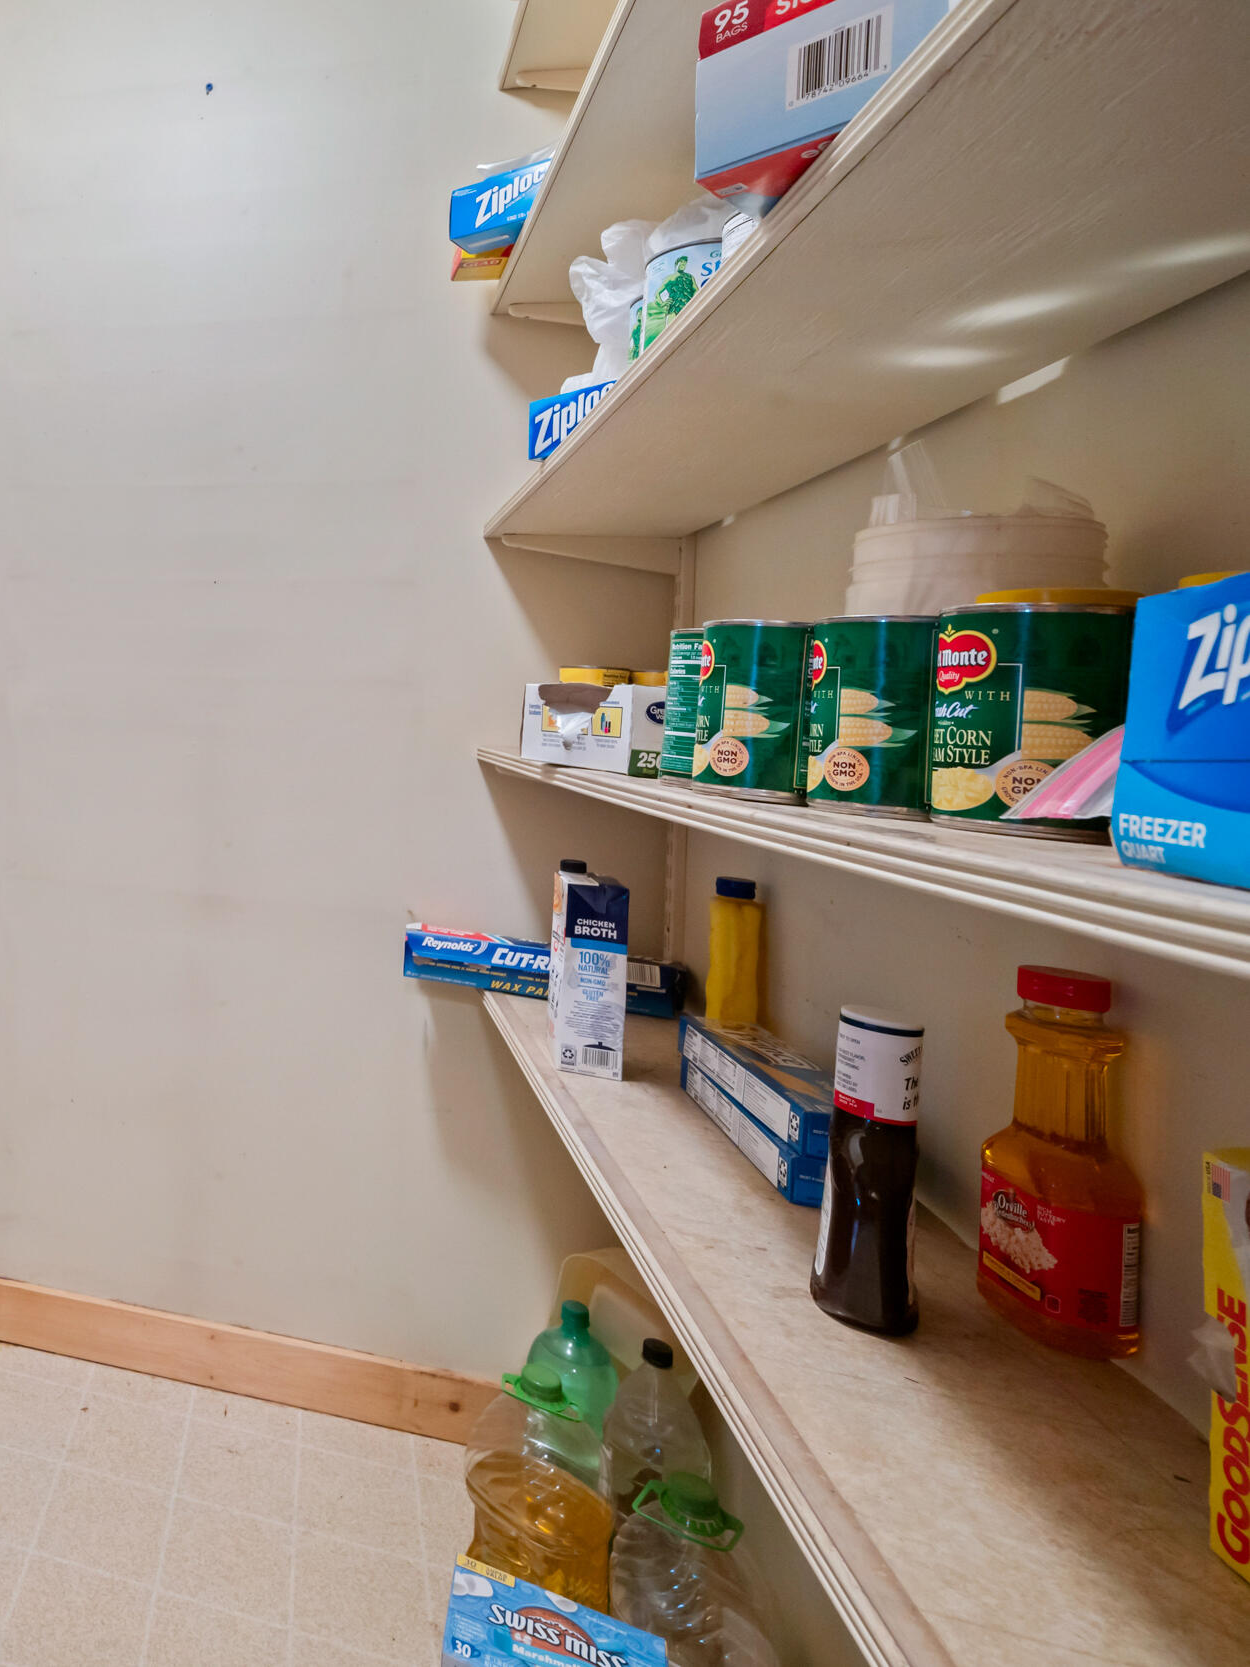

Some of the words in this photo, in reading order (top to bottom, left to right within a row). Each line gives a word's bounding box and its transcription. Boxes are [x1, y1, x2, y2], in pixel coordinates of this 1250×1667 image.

[714, 0, 749, 33] 95
[716, 22, 748, 43] BAGS
[475, 166, 547, 229] Ziploc
[942, 648, 988, 667] Monte
[939, 670, 960, 682] Quality
[964, 690, 1011, 701] WITH
[946, 726, 992, 747] CORN
[716, 756, 737, 764] GMO
[946, 745, 990, 765] STYLE
[832, 769, 856, 777] GMO
[833, 762, 856, 770] NON
[1119, 813, 1207, 848] FREEZER
[1121, 840, 1166, 865] QUART
[574, 925, 617, 940] BROTH
[577, 918, 616, 930] CHICKEN
[422, 936, 475, 952] Reynolds
[491, 947, 550, 971] CUT-R
[579, 951, 611, 968] 100%
[578, 964, 610, 976] NATURAL
[490, 980, 522, 992] WAX
[580, 977, 607, 987] NON-GMO
[998, 1194, 1028, 1218] Orville
[488, 1604, 561, 1646] SWISS
[454, 1640, 471, 1658] 30
